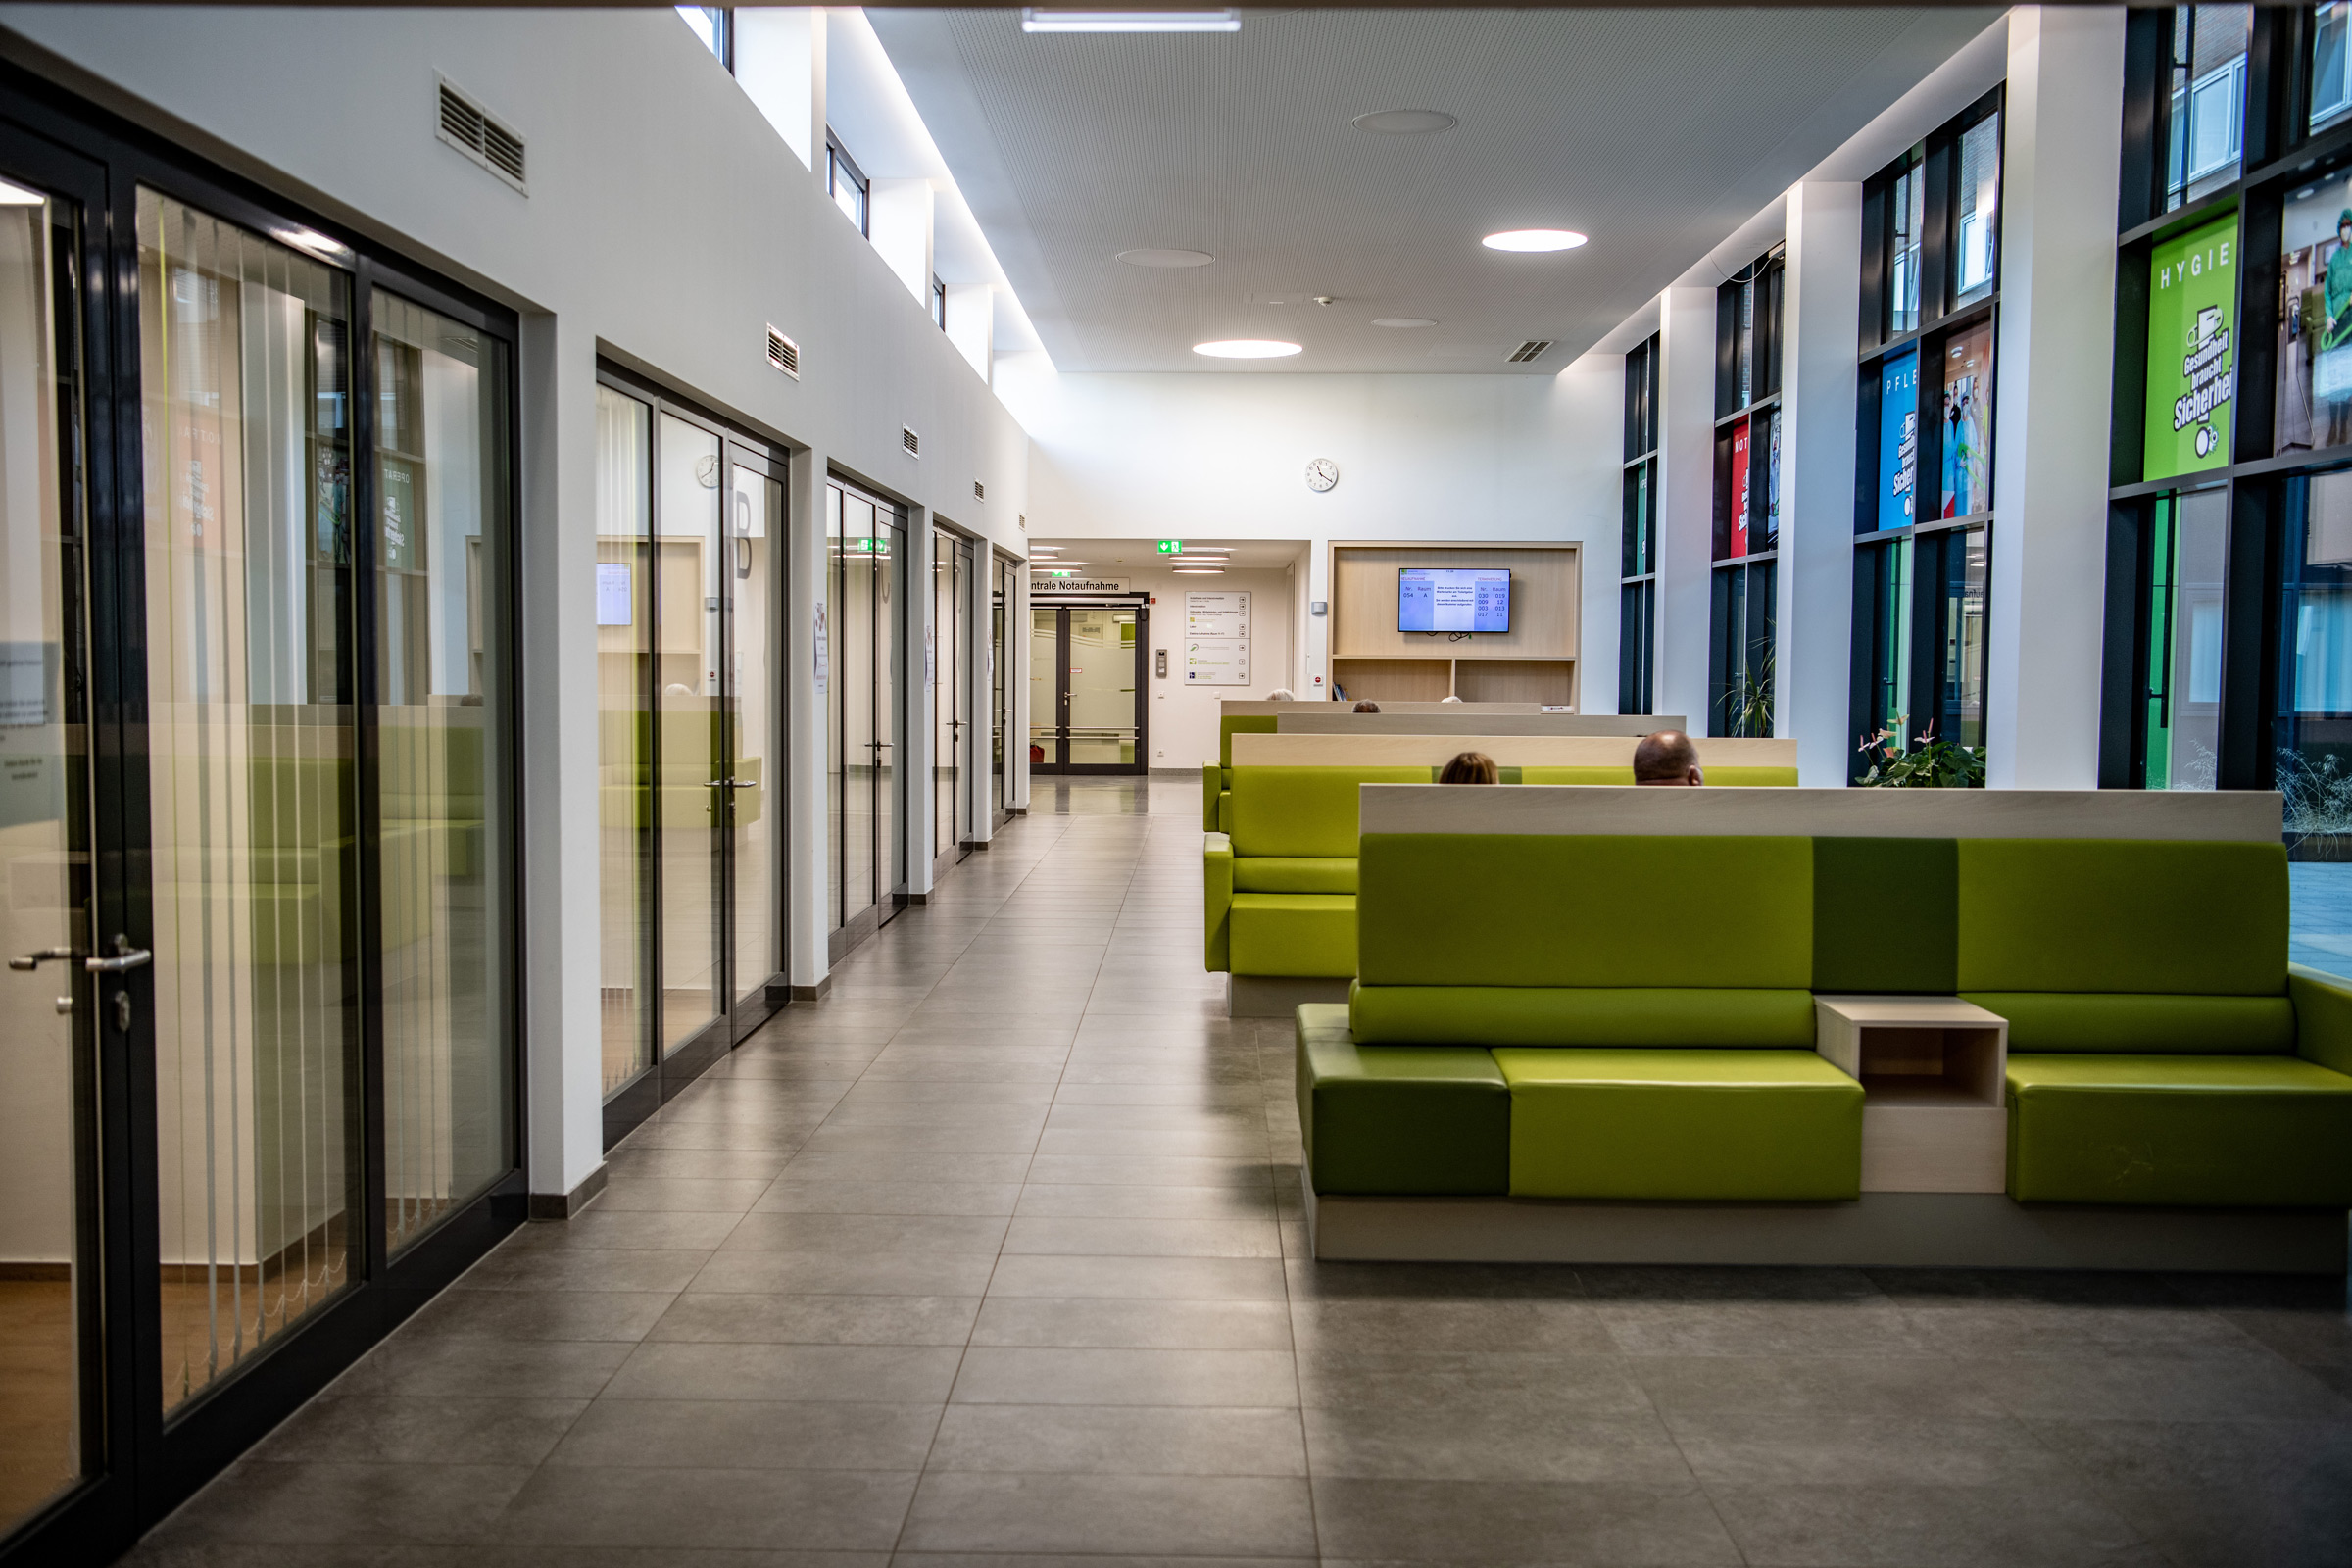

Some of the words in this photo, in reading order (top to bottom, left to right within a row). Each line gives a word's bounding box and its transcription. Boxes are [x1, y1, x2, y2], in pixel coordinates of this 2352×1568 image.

[2160, 242, 2230, 289] HYGIE
[2184, 329, 2229, 376] Gesundheit
[2191, 354, 2222, 391] braucht
[1886, 368, 1917, 395] PFLE
[736, 490, 752, 580] B
[1031, 580, 1056, 590] ntrale
[1059, 581, 1119, 590] Notaufnahme
